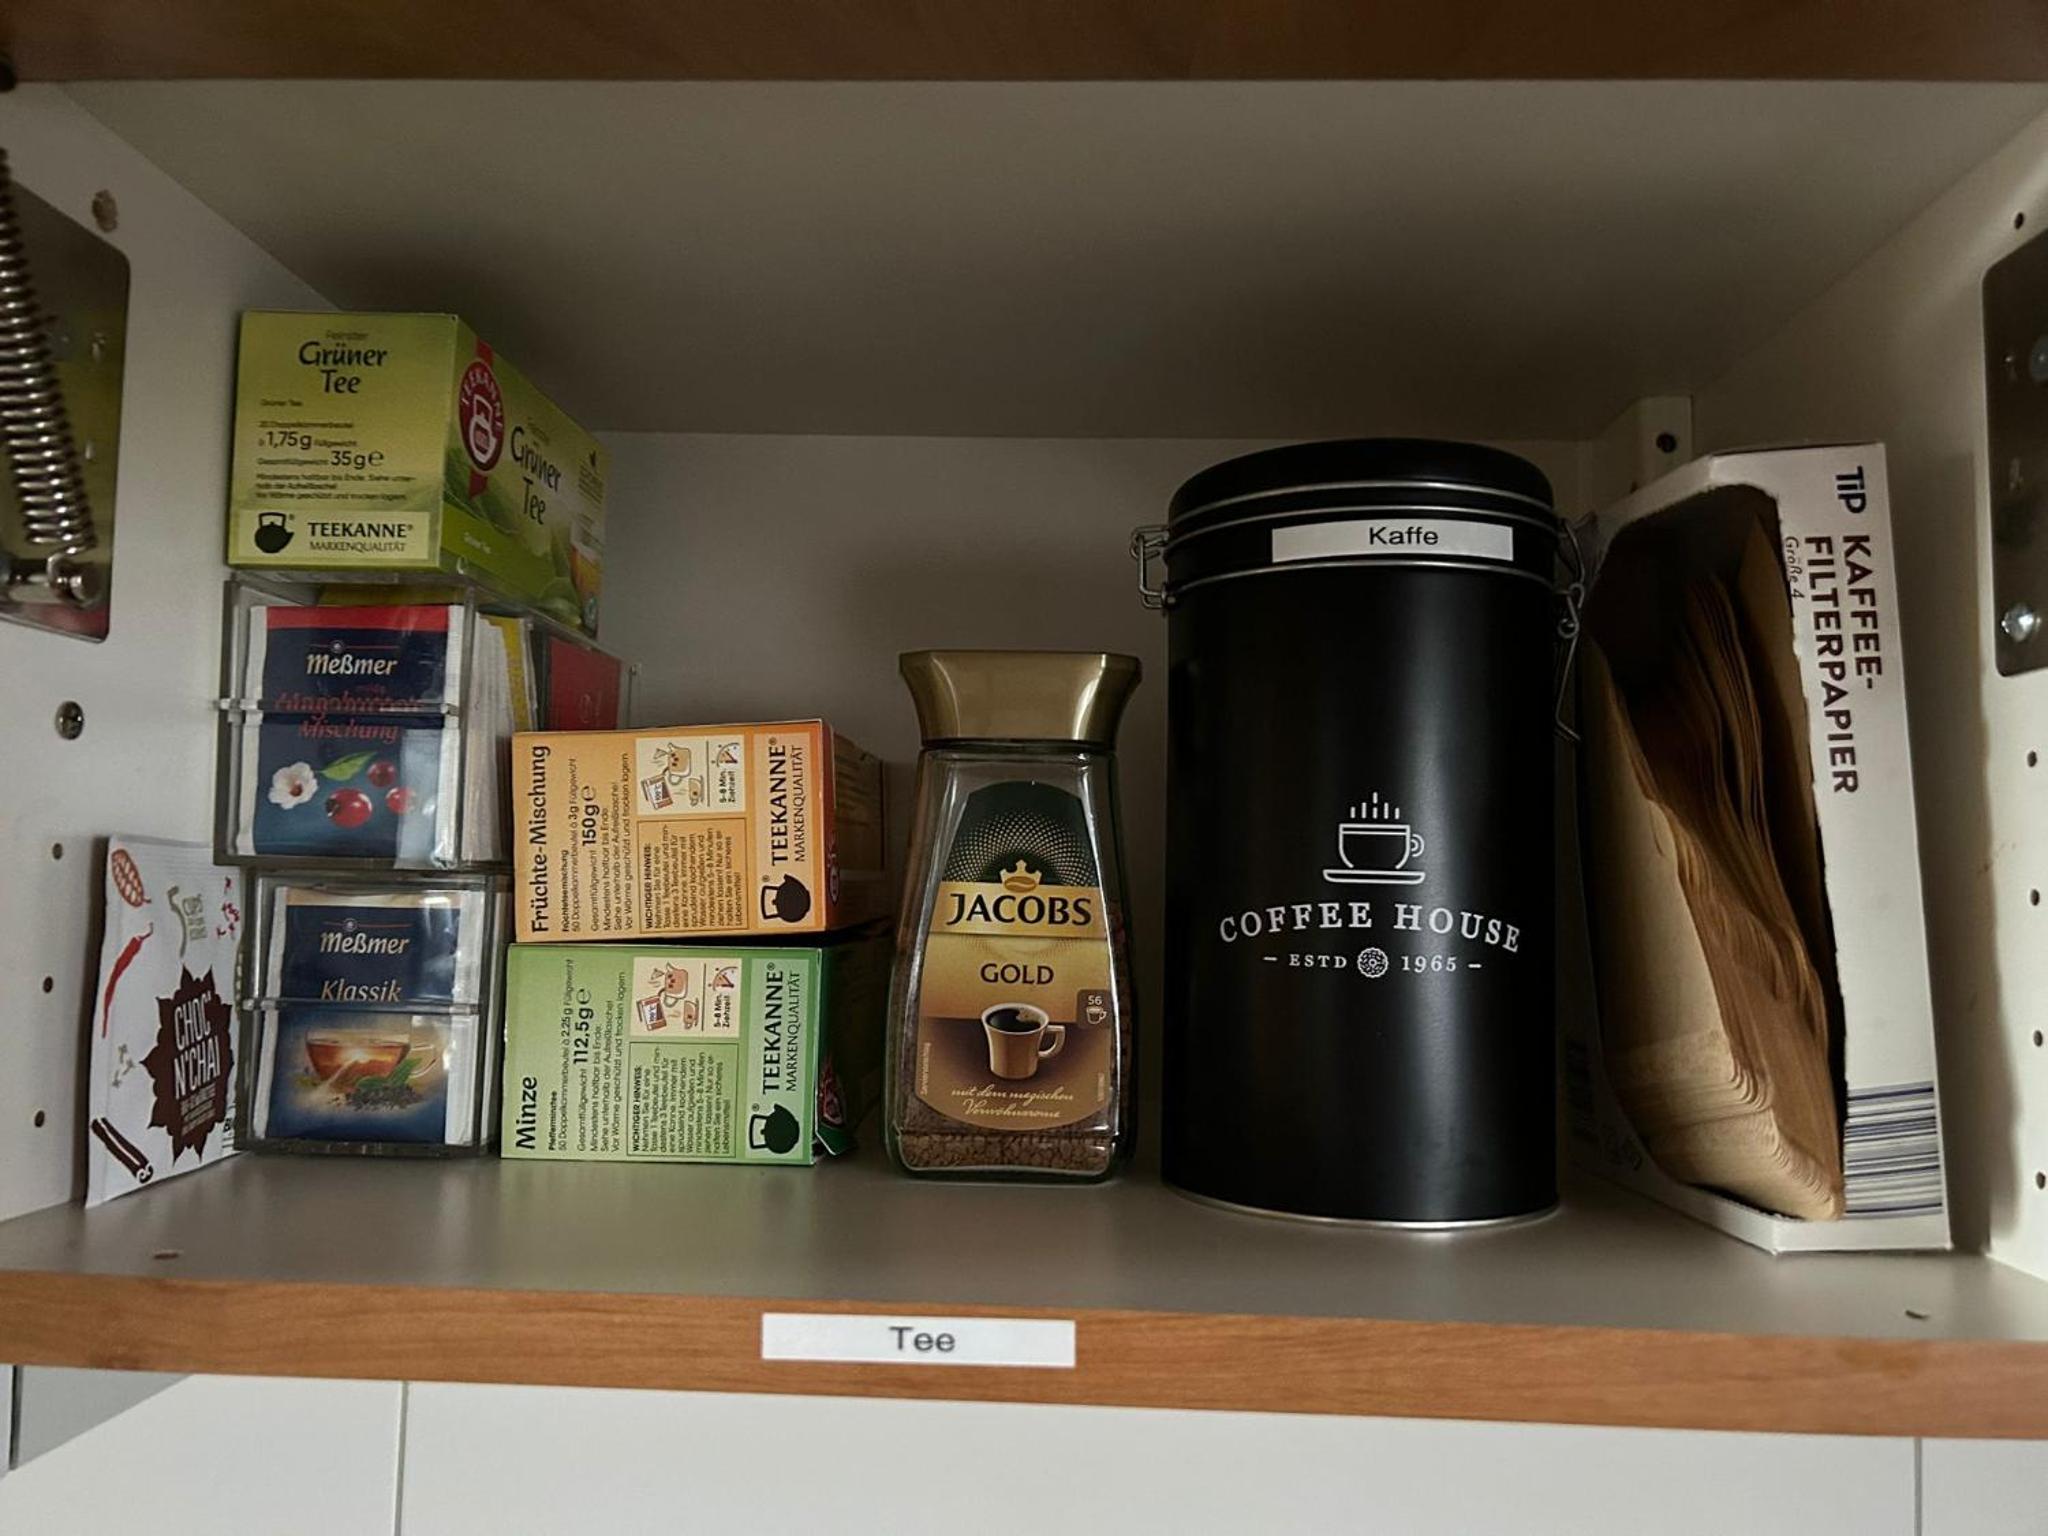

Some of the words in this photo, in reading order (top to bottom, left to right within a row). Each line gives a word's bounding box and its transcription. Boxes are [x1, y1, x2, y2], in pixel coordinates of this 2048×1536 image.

[298, 341, 388, 366] Grüner
[320, 370, 362, 394] Tee
[511, 426, 562, 492] Grüner
[522, 476, 546, 525] Tee
[1369, 526, 1439, 546] Kaffe
[1791, 588, 1805, 600] 4
[1842, 535, 1882, 690] KAFFEE-
[306, 653, 398, 676] Meßmer
[1804, 536, 1859, 794] FILTERPAPIER
[299, 719, 399, 744] Mischung
[791, 745, 805, 862] MARKENQUALITÄT
[528, 746, 550, 932] Früchte-Mischung
[946, 894, 1092, 926] JACOBS
[1220, 902, 1372, 942] COFFEE
[1393, 903, 1521, 952] HOUSE
[320, 932, 410, 955] Meßmer
[980, 963, 1054, 985] GOLD
[1289, 953, 1347, 969] ESTD
[1401, 955, 1457, 972] 1965
[320, 979, 402, 1002] Klassik
[1087, 994, 1103, 1006] 56
[785, 970, 800, 1091] MARKENQUALITÄT
[516, 1076, 537, 1149] Minze
[888, 1326, 956, 1352] Tee
